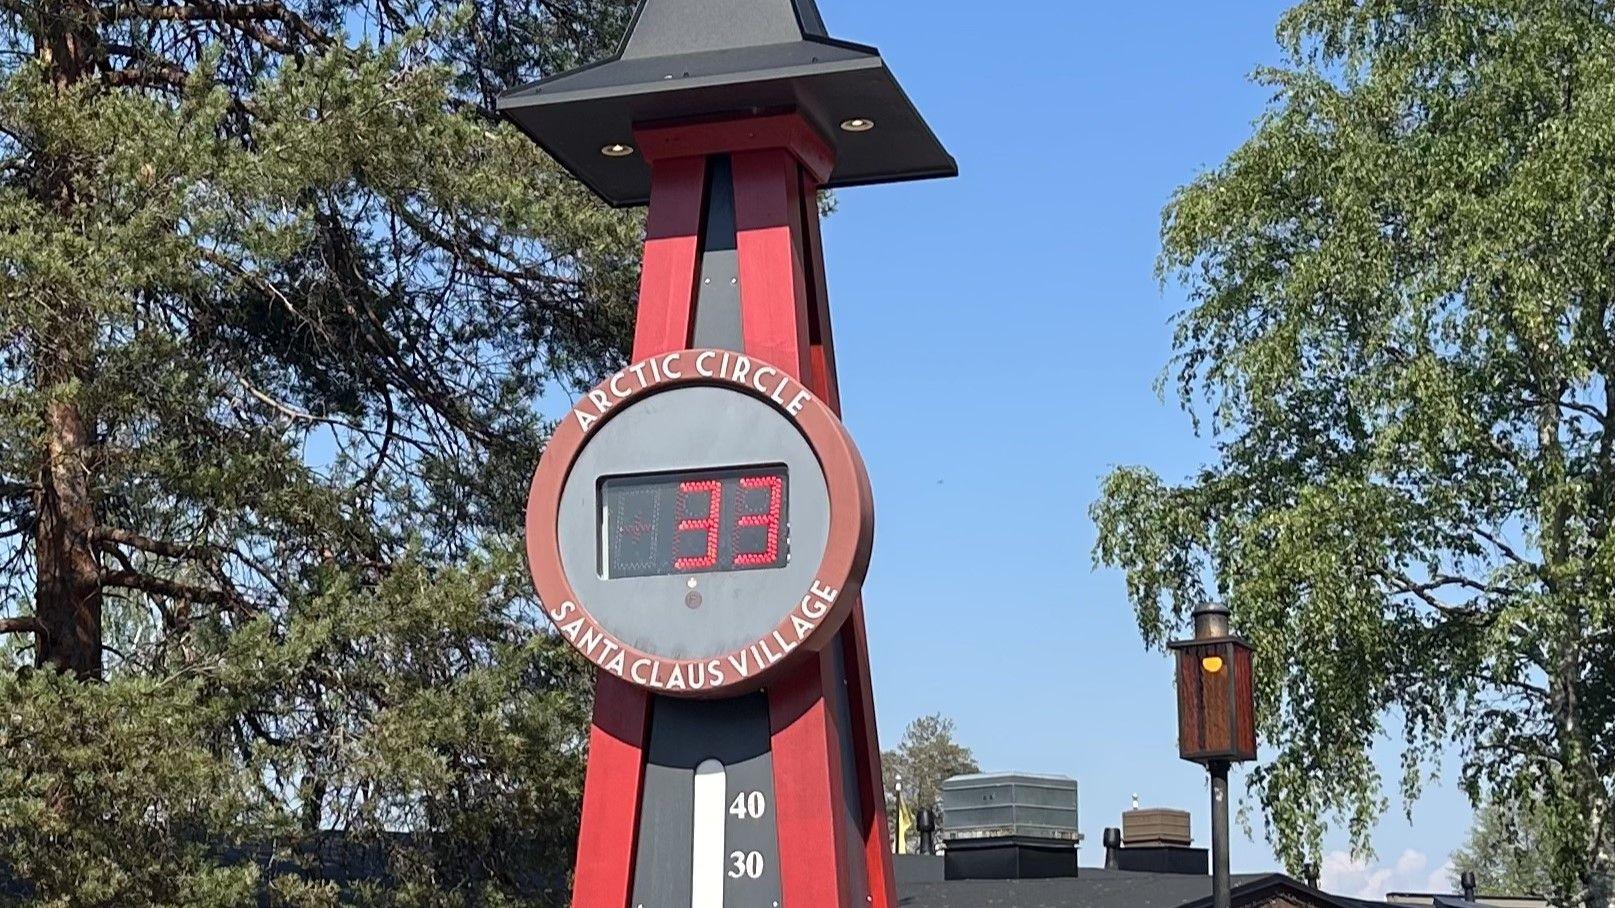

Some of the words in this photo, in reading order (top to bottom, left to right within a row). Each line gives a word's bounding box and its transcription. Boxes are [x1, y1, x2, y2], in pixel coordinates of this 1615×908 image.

[573, 353, 682, 432] ARCTIC
[695, 351, 812, 416] CIRCLE
[674, 476, 782, 569] 33
[551, 600, 624, 676] SANTA
[631, 660, 725, 690] CLAUS
[728, 580, 838, 677] VILLAGE
[729, 791, 765, 819] 40
[728, 851, 764, 878] 30
